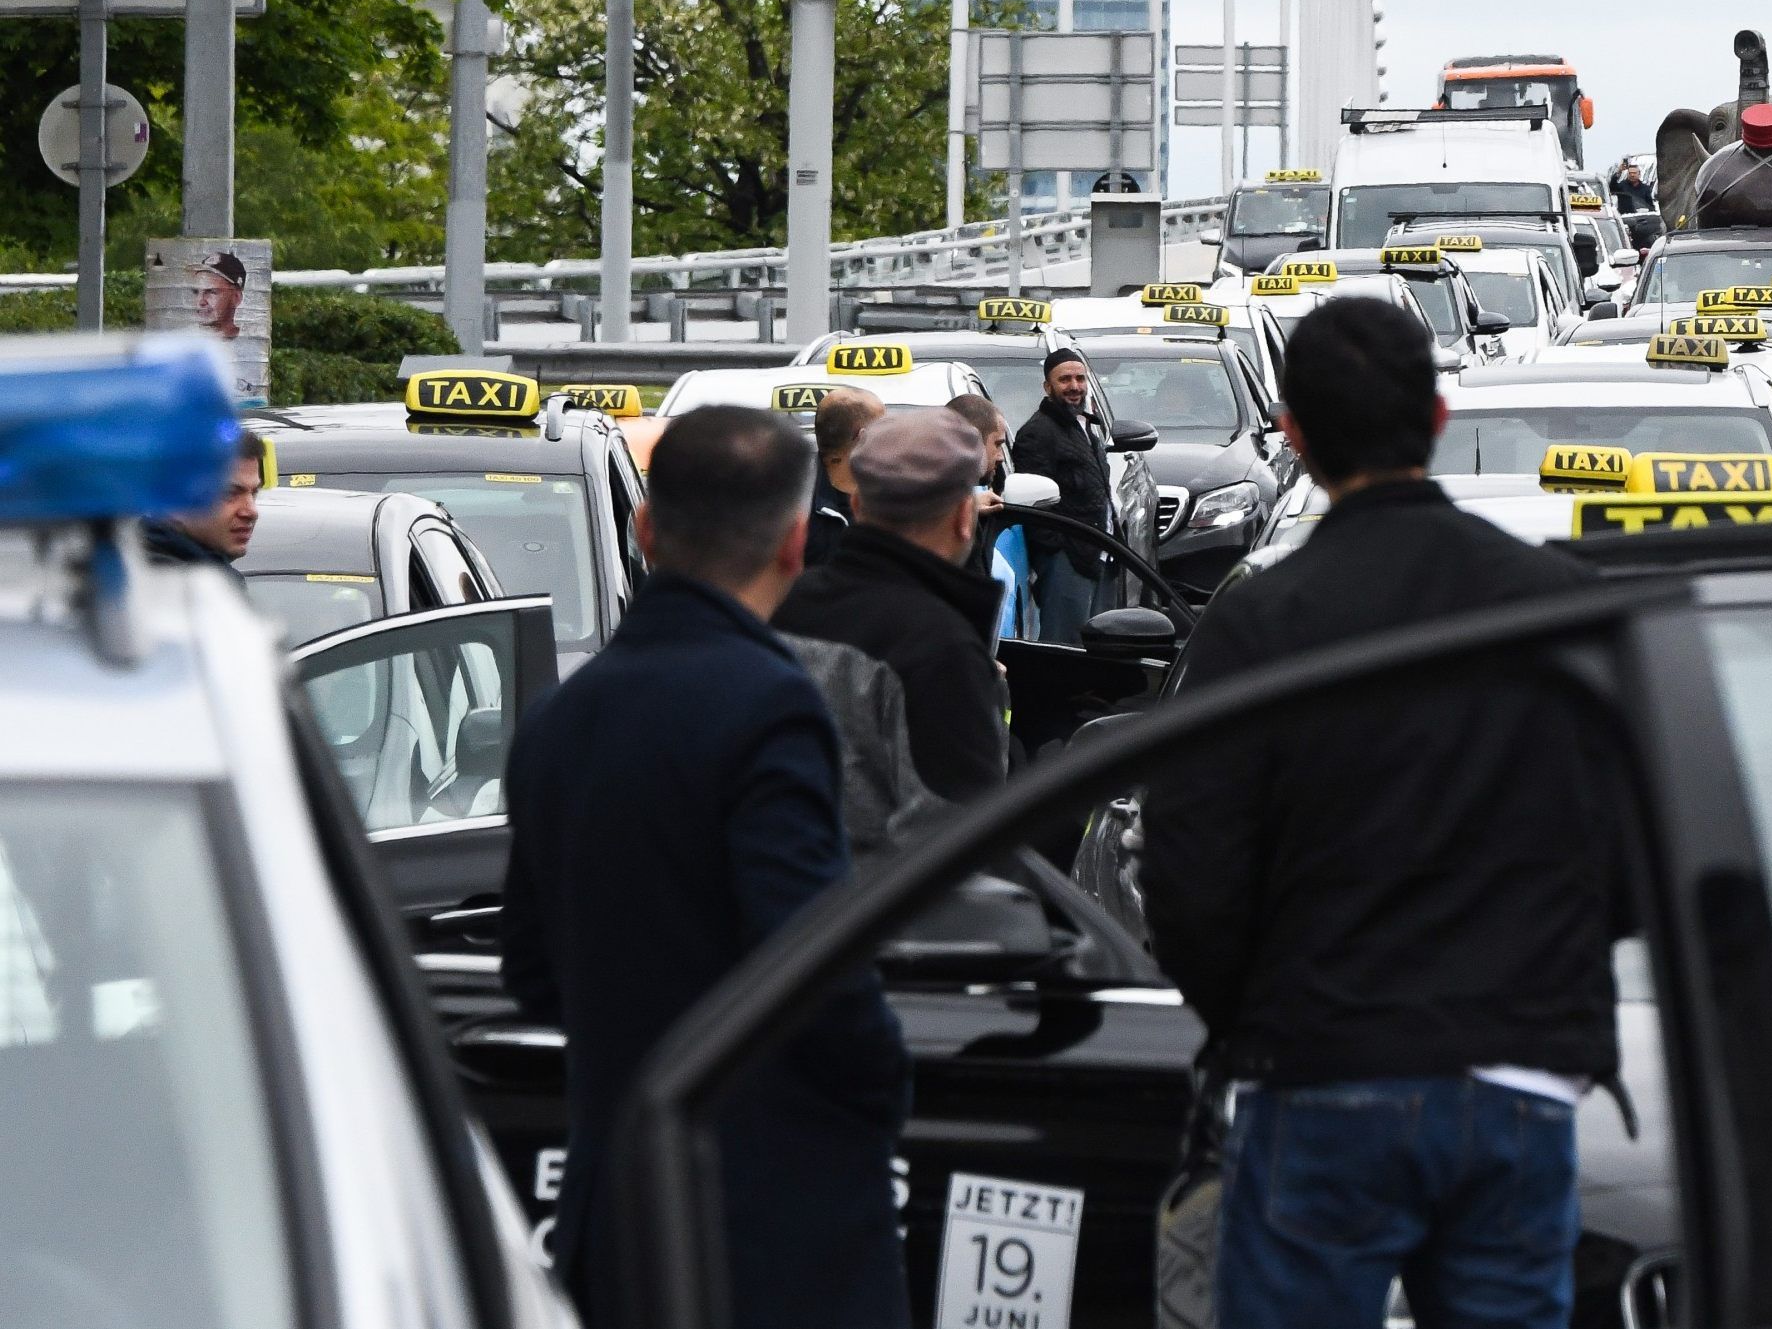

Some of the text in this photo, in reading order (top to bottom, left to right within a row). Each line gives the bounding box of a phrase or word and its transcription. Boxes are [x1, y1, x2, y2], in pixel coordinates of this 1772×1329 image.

[1442, 236, 1474, 246] TAXI
[1390, 251, 1431, 262] TAXI
[1289, 264, 1328, 276] TAXI
[1151, 285, 1195, 301] TAXI
[1260, 278, 1291, 289] TAXI
[1705, 291, 1725, 306] TA
[990, 302, 1042, 319] TAXI
[1174, 306, 1218, 321] TAXI
[1696, 319, 1755, 334] TAXI
[1657, 337, 1717, 357] TAXI
[839, 348, 899, 368] TAXI
[426, 380, 518, 408] TAXI
[570, 388, 625, 409] TAXI
[783, 388, 829, 408] TA
[1558, 453, 1621, 473] TAXI
[1657, 461, 1766, 492] TAXI
[955, 1184, 1077, 1225] JETZT!
[971, 1234, 1042, 1304] 19.
[964, 1304, 1041, 1329] JUNI
